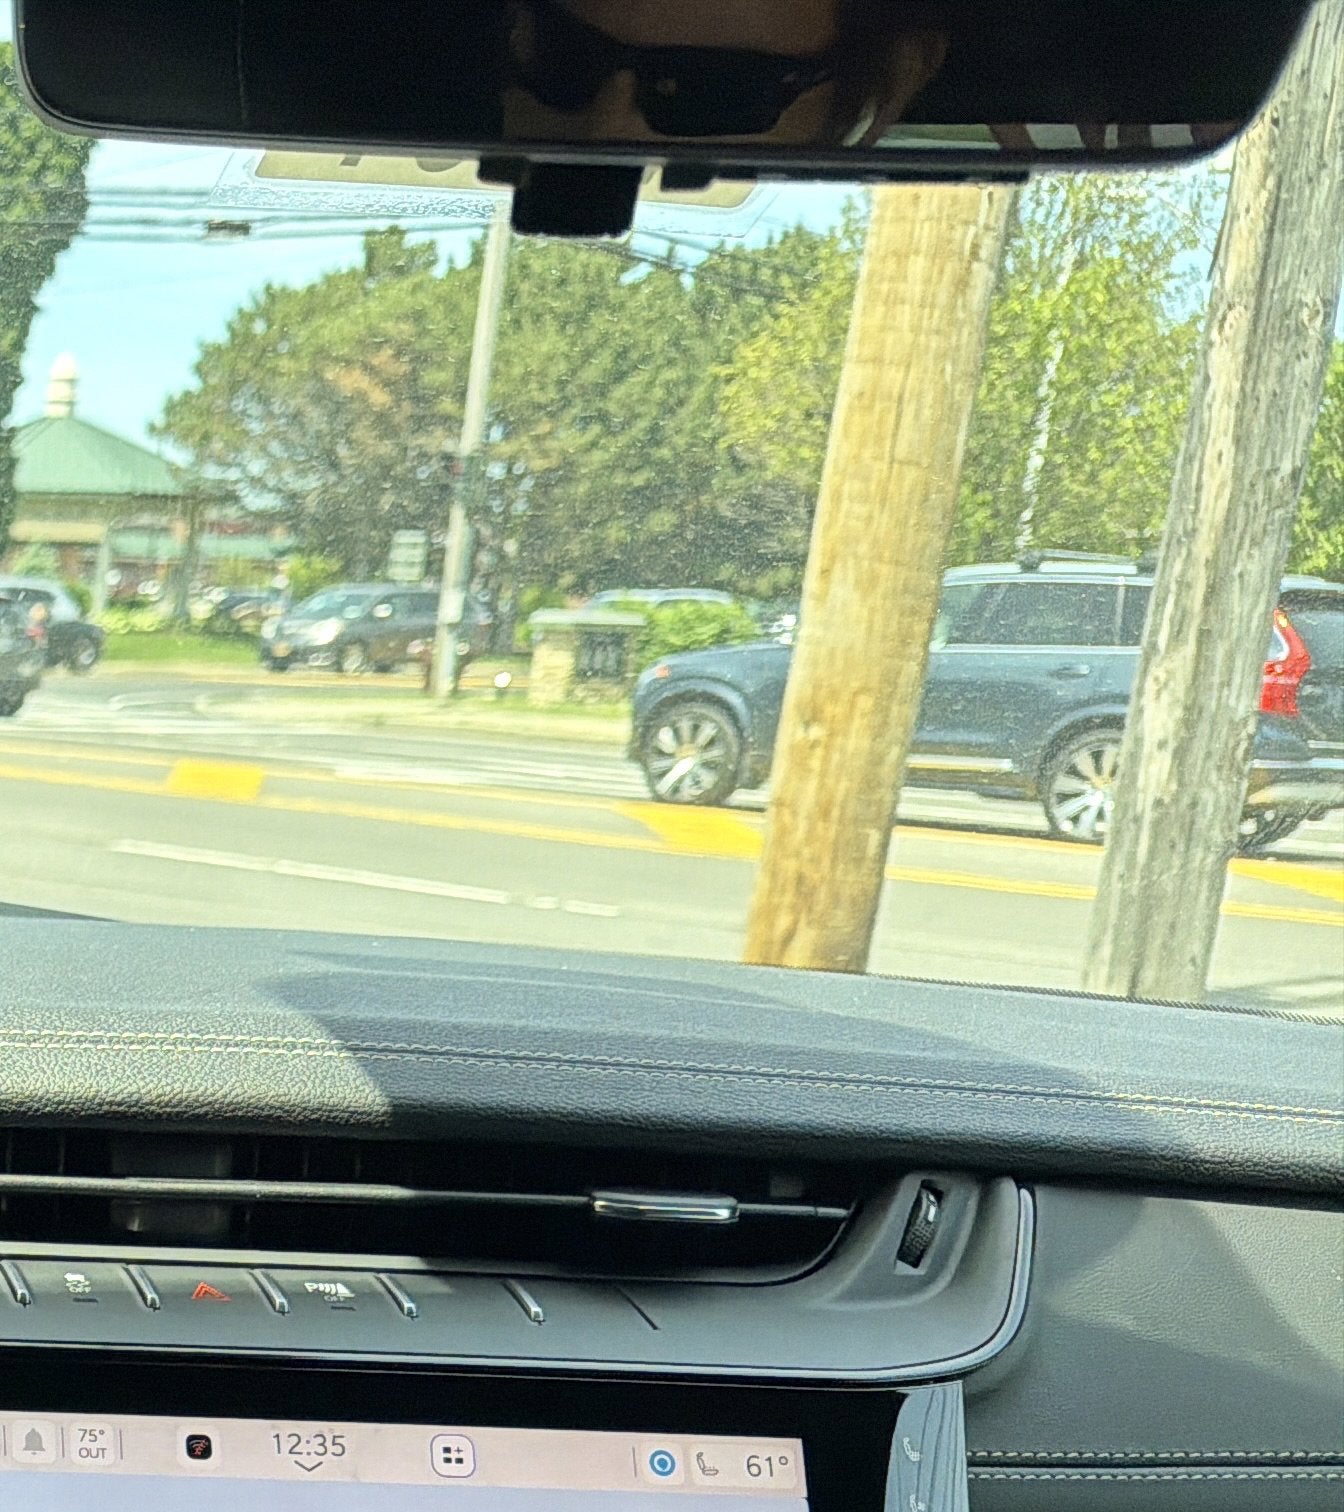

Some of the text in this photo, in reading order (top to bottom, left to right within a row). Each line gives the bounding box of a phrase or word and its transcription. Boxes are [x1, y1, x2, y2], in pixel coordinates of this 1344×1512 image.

[77, 1428, 106, 1443] 75°
[272, 1433, 347, 1458] 12:35
[78, 1446, 108, 1460] OUT
[745, 1454, 789, 1480] 61°
